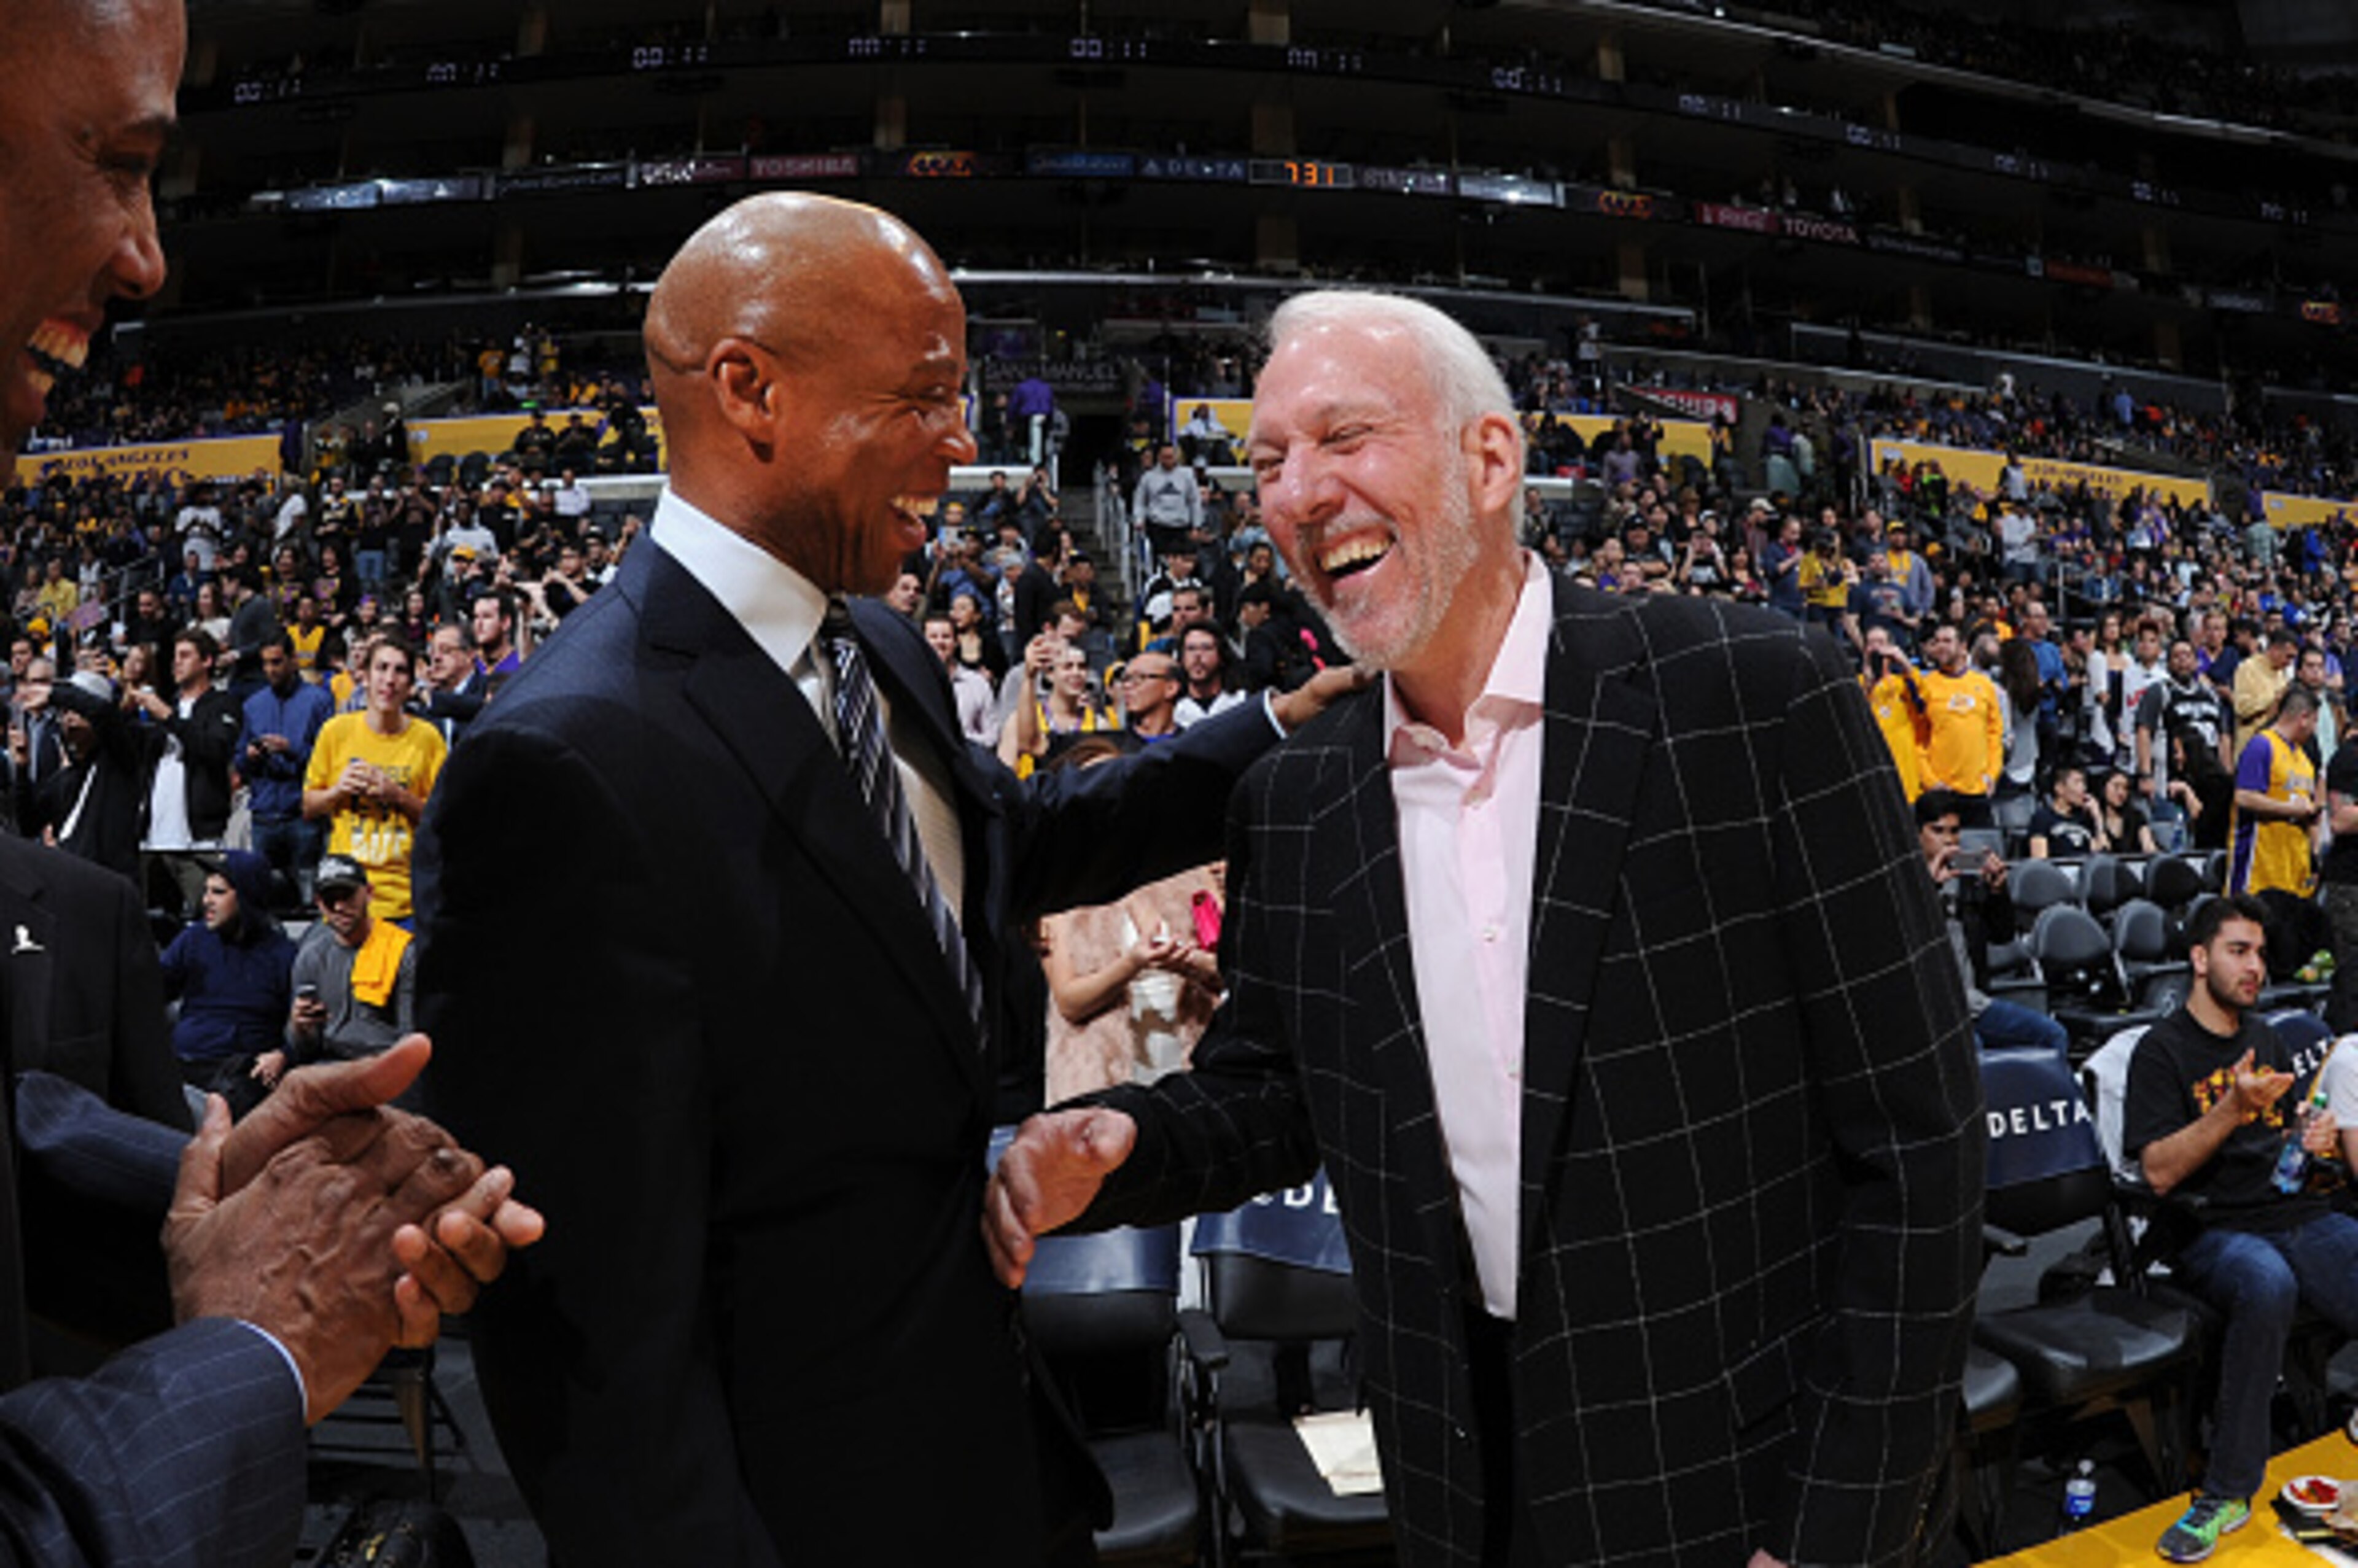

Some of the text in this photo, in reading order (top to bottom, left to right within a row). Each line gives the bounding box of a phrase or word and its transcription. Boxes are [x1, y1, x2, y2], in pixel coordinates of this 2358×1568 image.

[752, 156, 855, 176] TOSHIBA
[1167, 158, 1243, 176] DELTA
[1783, 217, 1859, 243] TOYOTA
[2292, 1036, 2332, 1077] ELT
[1987, 1099, 2093, 1139] DELTA
